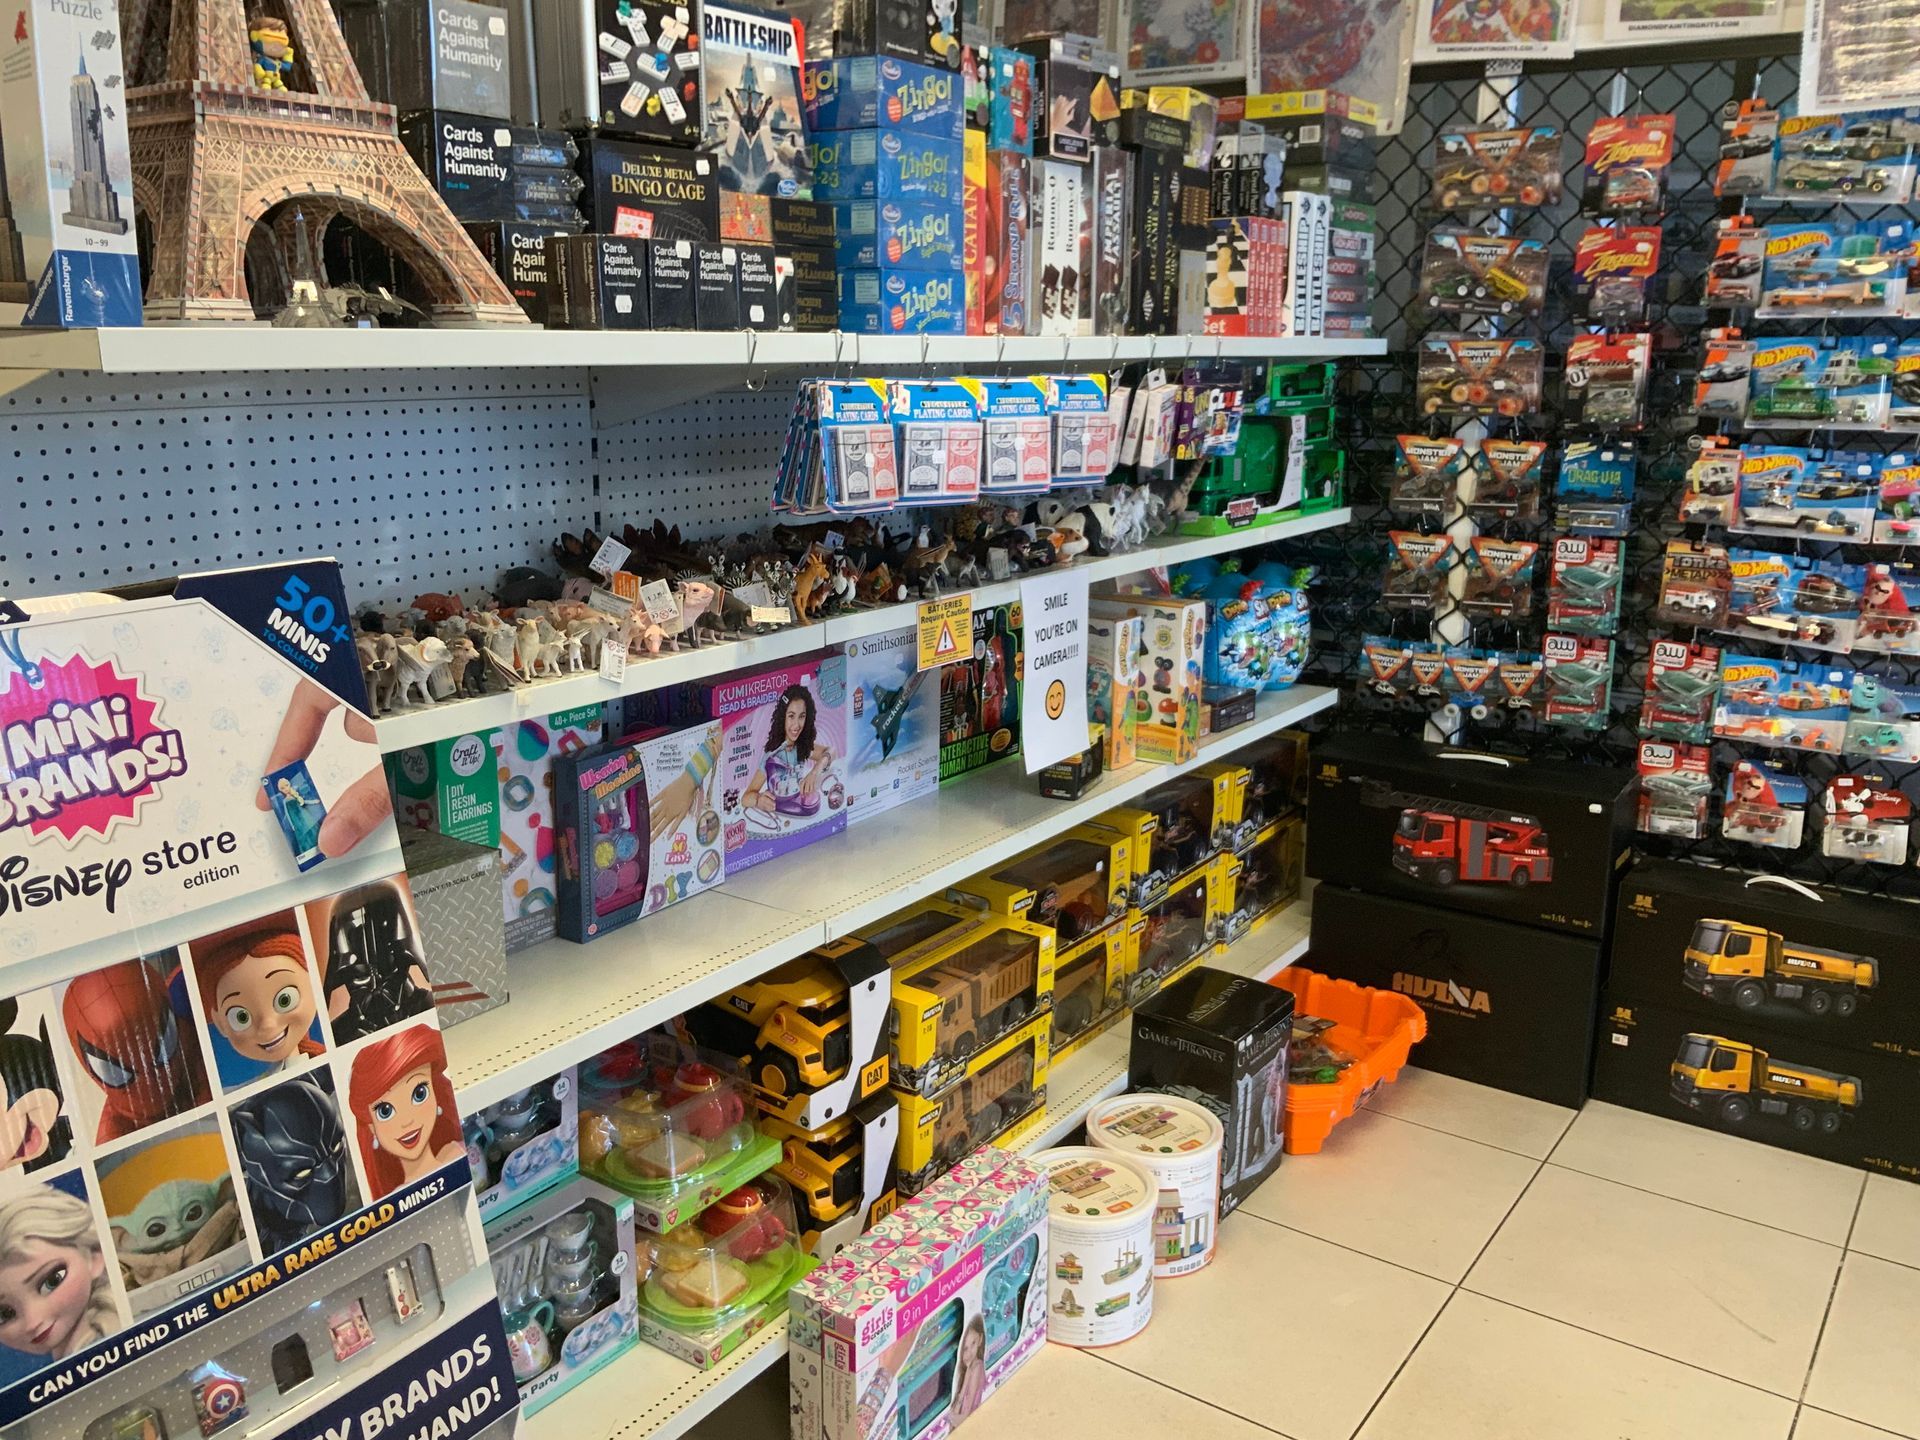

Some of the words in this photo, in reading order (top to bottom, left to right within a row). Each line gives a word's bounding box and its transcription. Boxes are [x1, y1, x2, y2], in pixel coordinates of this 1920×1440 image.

[438, 9, 479, 31] Cards
[439, 27, 490, 50] Against
[704, 13, 793, 57] BATTLESHIP
[440, 44, 502, 72] Humanity
[897, 75, 953, 117] Zingo!
[443, 124, 483, 144] Cards
[1779, 118, 1802, 136] HOT
[444, 142, 494, 161] Against
[1475, 138, 1522, 149] MONSTER
[445, 158, 508, 181] Humanity
[622, 162, 663, 177] DELUXE
[664, 168, 696, 182] METAL
[898, 150, 949, 180] Zingo!
[611, 175, 662, 197] BINGO
[666, 182, 705, 201] CAGE
[1151, 174, 1160, 206] SET
[964, 184, 977, 266] CATAN
[1103, 168, 1119, 265] IMPERIAL
[1112, 181, 1122, 257] ASSAULT
[511, 233, 545, 250] Card
[897, 214, 950, 254] Zingo!
[1766, 239, 1789, 256] HOT
[1788, 232, 1831, 249] WHEELS
[602, 242, 628, 254] Cards
[654, 245, 677, 257] Cards
[699, 250, 721, 260] Cards
[741, 252, 762, 262] Cards
[1464, 245, 1510, 255] MONSTER
[604, 254, 634, 266] Against
[655, 256, 683, 268] Against
[700, 260, 727, 271] Against
[742, 263, 767, 273] Against
[604, 265, 642, 278] Humanity
[654, 267, 690, 280] Humanity
[700, 271, 734, 283] Humanity
[742, 272, 774, 284] Humanity
[1294, 217, 1309, 332] BATTLESHIP
[1310, 219, 1325, 332] BATTLESHIP
[63, 254, 73, 323] Ravensburger
[901, 279, 953, 321] Zingo!
[1002, 301, 1023, 330] 5
[1203, 319, 1227, 334] Set
[1458, 348, 1502, 357] MONSTER
[1754, 351, 1778, 367] HOT
[1777, 346, 1816, 363] WHEELS
[913, 407, 946, 419] PLAYING
[947, 406, 973, 418] CARDS
[990, 405, 1015, 416] PLAYING
[1016, 403, 1040, 414] CARDS
[1061, 401, 1083, 410] PLAYING
[1084, 400, 1102, 409] CARDS
[1211, 389, 1244, 416] CLUE
[836, 410, 859, 423] PLAYING
[860, 409, 879, 422] CARDS
[1405, 448, 1452, 457] MONSTER
[1417, 455, 1438, 464] JAM
[1489, 452, 1533, 461] MONSTER
[1743, 458, 1766, 474] HOT
[1765, 456, 1804, 471] WHEELS
[1397, 543, 1442, 553] MONSTER
[1409, 551, 1430, 559] JAM
[1479, 550, 1525, 561] MONSTER
[1491, 558, 1512, 566] JAM
[1673, 554, 1729, 570] Tonka
[275, 574, 350, 646] 50+
[1011, 606, 1021, 617] 60
[1044, 593, 1068, 612] SMILE
[921, 613, 945, 625] Require
[946, 607, 970, 619] Caution
[266, 607, 331, 664] MINIS
[1035, 622, 1064, 644] YOU'RE
[1065, 619, 1078, 635] ON
[263, 627, 279, 643] TO
[275, 636, 320, 674] COLLECT!
[1034, 644, 1079, 671] CAMERA!!!!
[719, 673, 789, 704] KUMIKREATOR
[719, 702, 741, 716] BEAD
[746, 691, 778, 708] BRAIDER
[554, 714, 568, 726] 40+
[568, 710, 588, 723] Piece
[588, 706, 598, 719] Set
[882, 699, 904, 731] rocket
[735, 725, 747, 735] SPIN
[453, 743, 478, 762] Craft
[461, 757, 469, 767] It
[469, 753, 481, 766] Up!
[917, 753, 938, 768] Science
[579, 753, 628, 791] Weaving
[940, 755, 968, 778] HUMAN
[968, 748, 989, 768] BODY
[451, 783, 465, 799] DIY
[595, 764, 643, 801] Machine
[452, 794, 477, 811] RESIN
[1870, 790, 1901, 805] Disney
[453, 802, 493, 824] EARRINGS
[142, 831, 237, 875] store
[664, 850, 692, 866] Easy!
[183, 861, 240, 890] edition
[453, 875, 471, 888] SCALE
[649, 870, 693, 913] DIY
[734, 997, 750, 1013] CAT
[1138, 1027, 1169, 1046] GAME
[1177, 1037, 1227, 1063] THRONES
[866, 1069, 884, 1088] CAT
[478, 1191, 499, 1208] arty
[876, 1200, 893, 1222] CAT
[504, 1213, 534, 1233] Party
[615, 1255, 625, 1265] 14
[28, 1373, 72, 1404] CAN
[75, 1344, 121, 1381] YOU
[123, 1324, 169, 1358] FIND
[173, 1303, 210, 1331] THE
[212, 1265, 281, 1311] ULTRA
[284, 1237, 338, 1276] RARE
[339, 1203, 396, 1246] GOLD
[398, 1176, 446, 1214] MINIS?
[901, 1310, 910, 1329] 2
[911, 1304, 922, 1319] in
[923, 1297, 930, 1313] 1
[933, 1253, 983, 1303] Jewellery
[860, 1304, 895, 1348] girl's
[870, 1318, 893, 1341] creator
[360, 1333, 493, 1440] BRANDS
[530, 1370, 560, 1394] Party
[407, 1376, 503, 1440] HAND!
